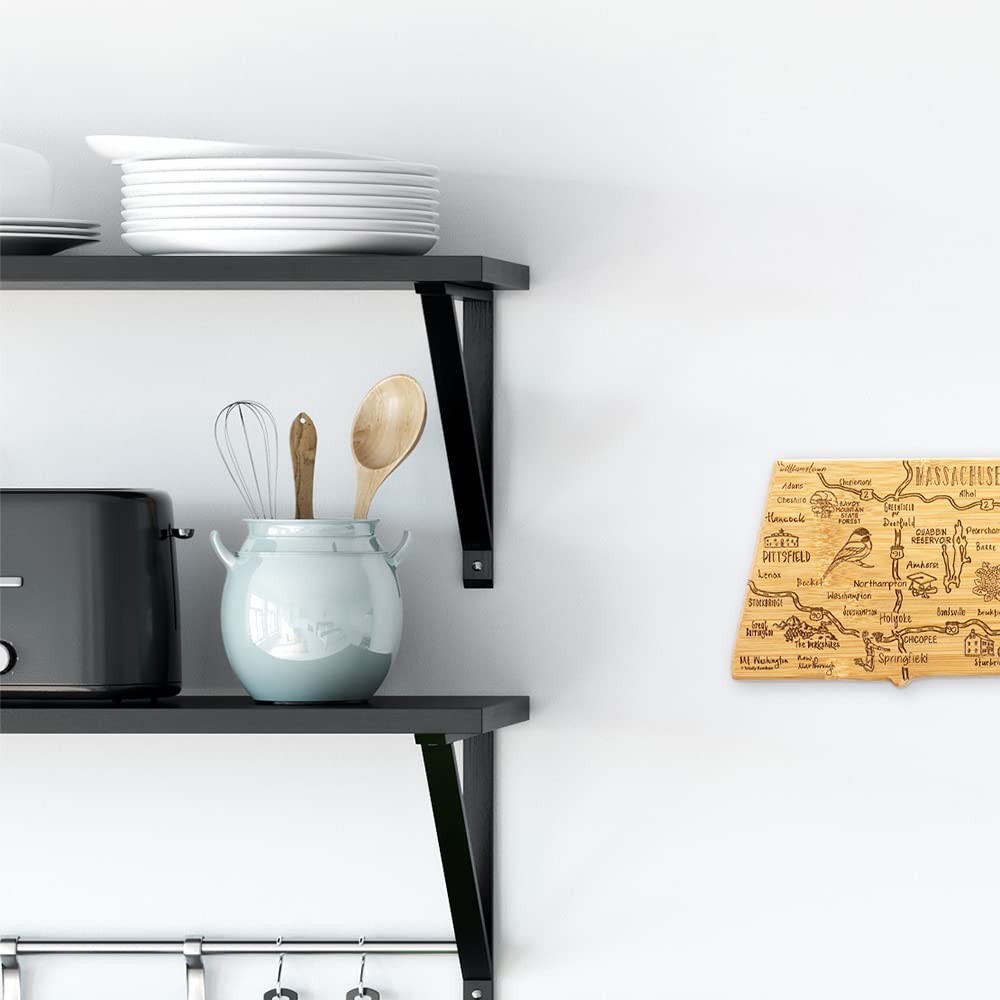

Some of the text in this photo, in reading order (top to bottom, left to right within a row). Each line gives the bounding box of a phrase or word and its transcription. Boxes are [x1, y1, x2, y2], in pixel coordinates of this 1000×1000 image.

[777, 461, 827, 473] Williamstown
[782, 482, 803, 490] Adams
[777, 496, 806, 504] Cheshire
[765, 512, 806, 523] Hancock
[883, 516, 916, 529] Deerfield
[966, 526, 1000, 535] Petersham
[763, 551, 811, 563] PITTSFIELD
[906, 560, 939, 569] Amherst
[758, 569, 781, 579] Lenox
[797, 578, 823, 587] Becket
[853, 580, 907, 590] Northampton
[880, 613, 912, 625] Holyoke
[794, 640, 806, 649] The
[904, 635, 937, 644] CHICOPEE
[879, 652, 928, 666] Springfield
